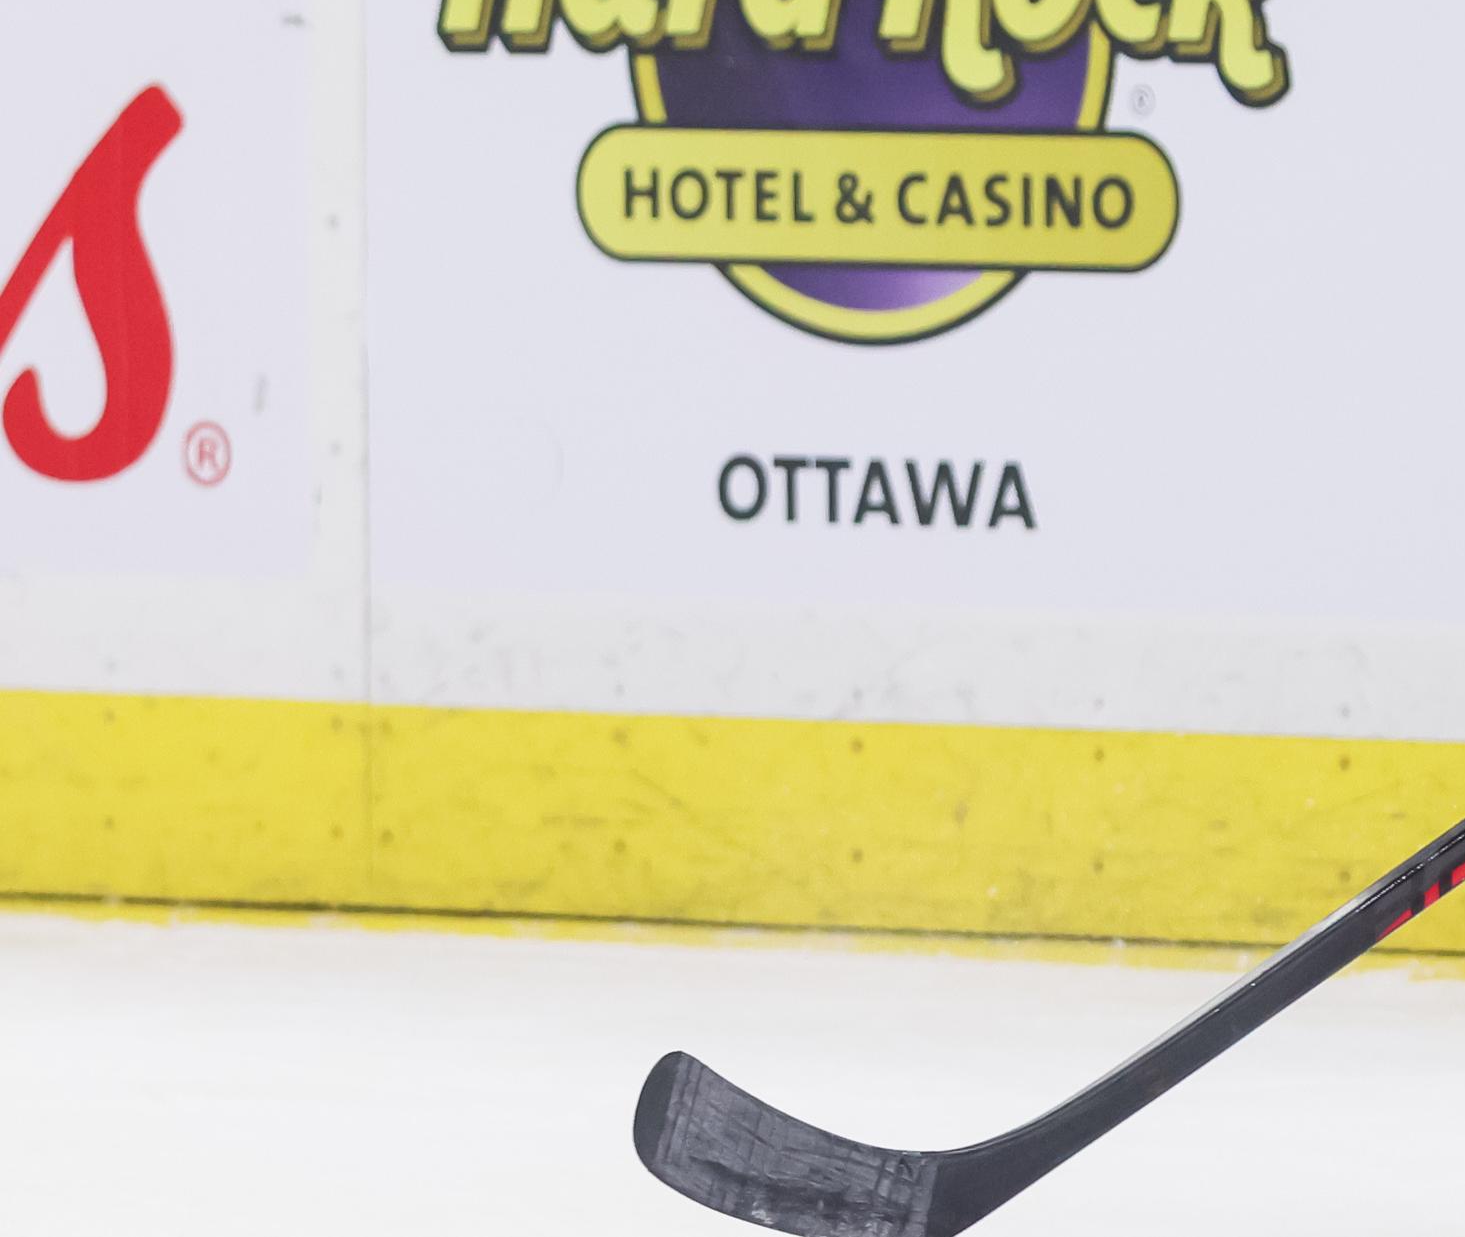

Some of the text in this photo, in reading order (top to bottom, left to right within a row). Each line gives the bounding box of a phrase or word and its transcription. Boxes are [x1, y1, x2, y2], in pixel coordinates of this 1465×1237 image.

[622, 167, 1136, 230] HOTEL & CASINO
[717, 453, 1038, 531] OTTAWA
